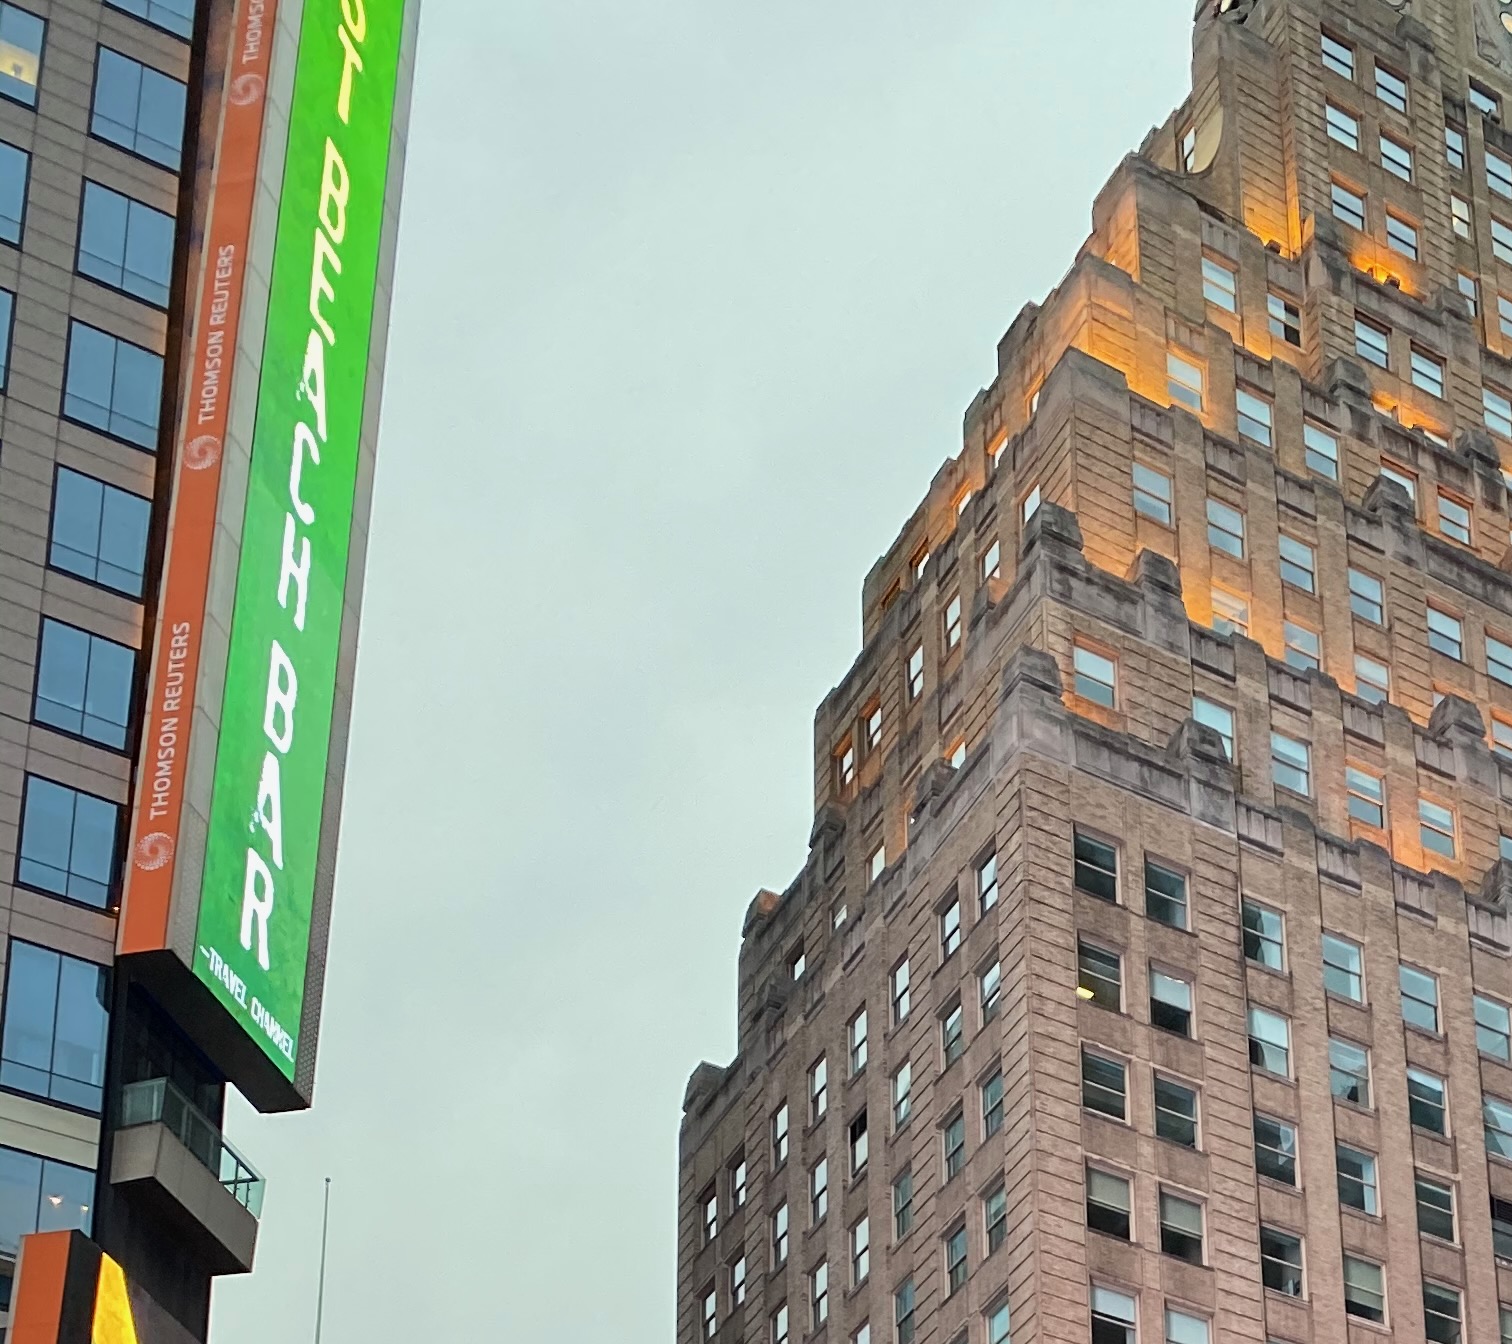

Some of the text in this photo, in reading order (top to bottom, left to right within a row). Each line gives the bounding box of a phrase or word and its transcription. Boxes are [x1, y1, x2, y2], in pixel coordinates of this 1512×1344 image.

[241, 0, 265, 64] THOMS
[199, 243, 235, 425] THOMSON REUTERS
[277, 136, 350, 631] BEACH
[149, 620, 191, 821] THOMSON REUTERS
[240, 640, 299, 970] BAR
[251, 996, 295, 1063] CHANNEL
